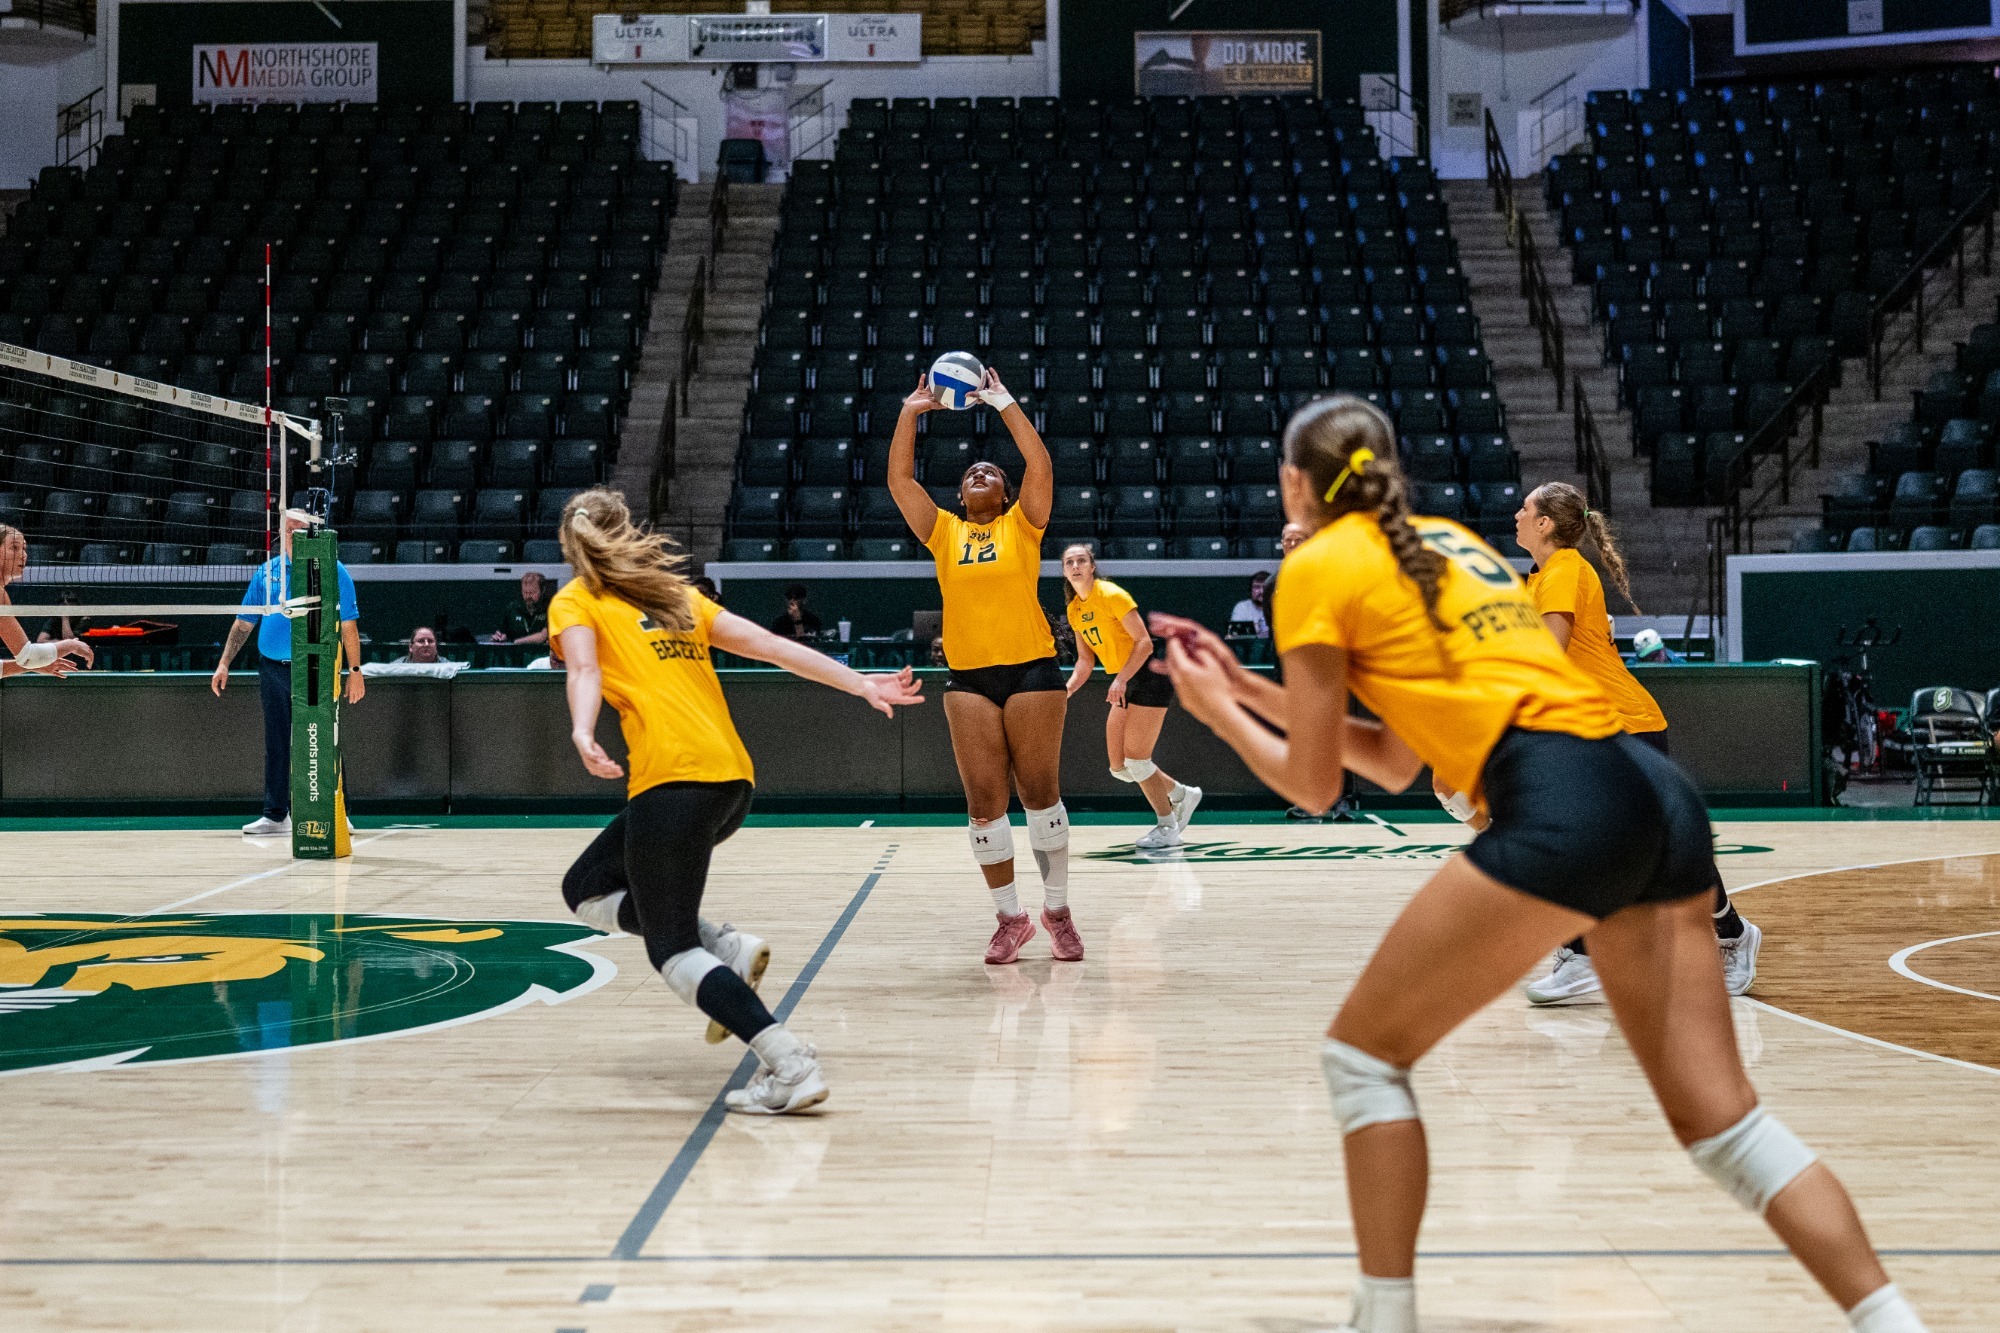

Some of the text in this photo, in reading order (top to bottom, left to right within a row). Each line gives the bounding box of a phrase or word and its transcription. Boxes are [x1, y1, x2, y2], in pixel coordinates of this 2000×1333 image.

[615, 27, 664, 39] ULTRA
[848, 26, 898, 38] ULTRA
[251, 48, 371, 67] NORTHSHORE
[1223, 42, 1247, 64] DO
[200, 49, 249, 88] NM
[251, 68, 372, 87] MEDIA GROUP
[957, 542, 997, 565] 12
[1082, 626, 1103, 647] 17
[307, 722, 319, 802] sports imports
